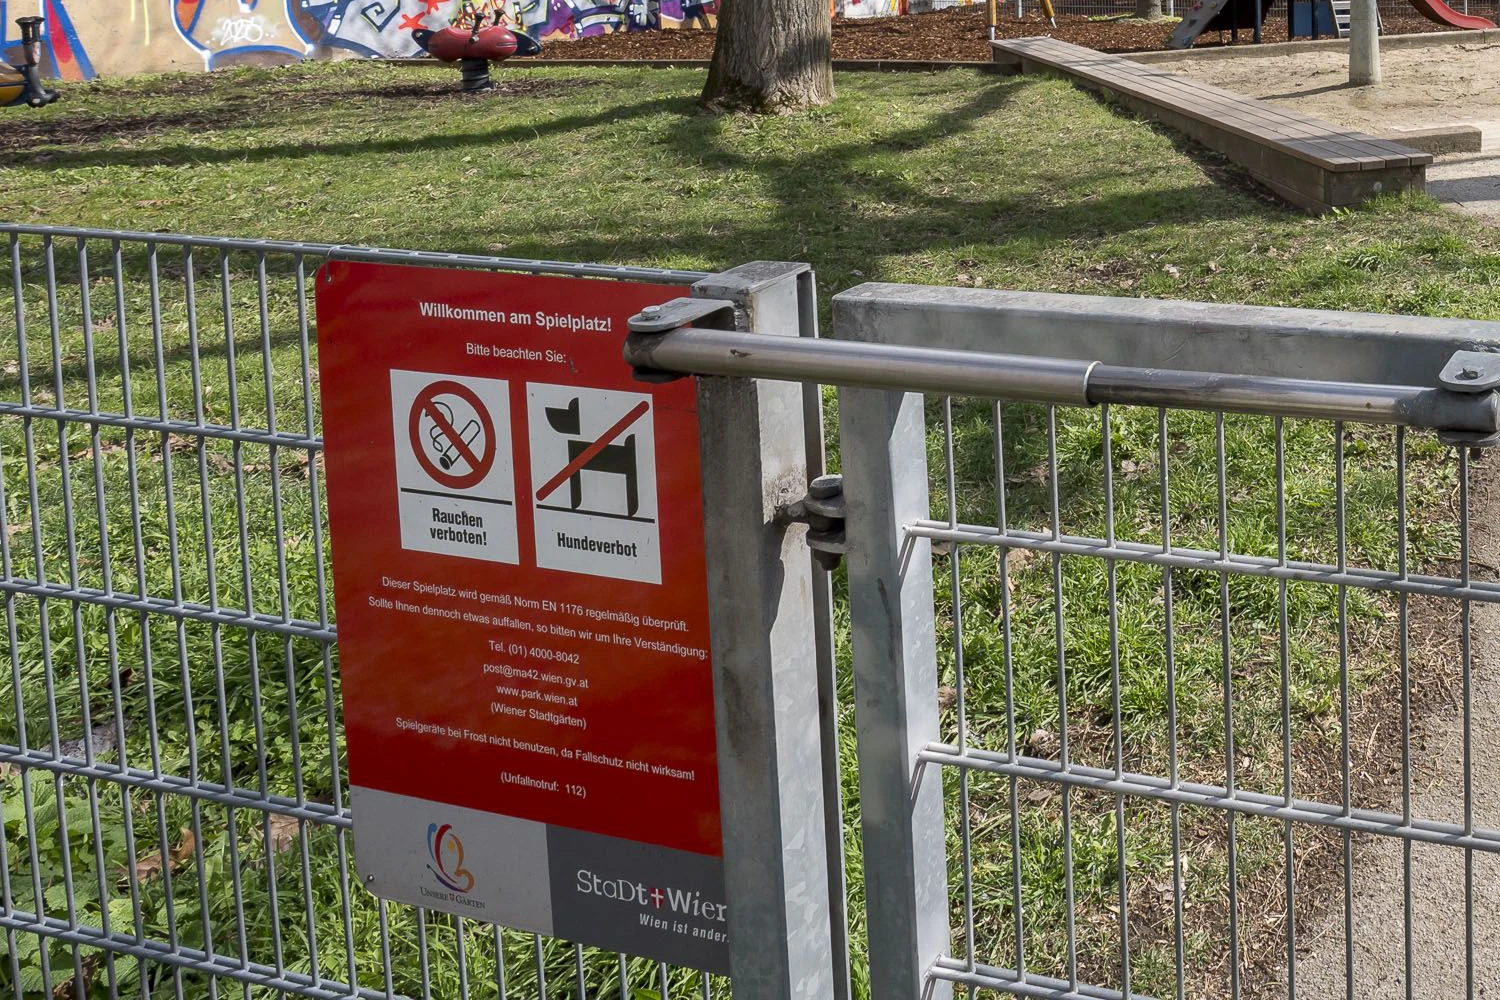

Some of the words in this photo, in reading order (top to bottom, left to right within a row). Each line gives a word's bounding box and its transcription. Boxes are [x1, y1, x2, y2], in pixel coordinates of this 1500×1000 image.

[420, 302, 505, 322] Willkommen
[510, 313, 531, 324] am
[536, 312, 611, 332] Spielplatz!
[466, 343, 490, 356] Bitte
[493, 345, 542, 360] beachten
[546, 350, 566, 363] Sie:
[432, 508, 483, 528] Rauchen
[430, 527, 486, 545] verboten!
[557, 532, 637, 557] Hundeverbot
[382, 576, 411, 589] Dieser
[413, 581, 456, 596] Spielplatz
[458, 589, 477, 599] wird
[480, 593, 512, 605] gemäß
[514, 596, 539, 609] Norm
[542, 600, 556, 612] EN
[560, 603, 583, 615] 1176
[586, 609, 639, 626] regelmäßig
[642, 616, 688, 631] überprüft.
[369, 596, 393, 609] Sollte
[396, 600, 420, 613] Ihnen
[423, 605, 460, 619] dennoch
[463, 612, 490, 624] etwas
[492, 617, 533, 632] auffallen,
[537, 624, 548, 633] so
[550, 624, 576, 637] bitten
[578, 630, 592, 639] wir
[595, 634, 610, 643] um
[613, 634, 631, 646] Ihre
[634, 637, 707, 660] Verständigung:
[489, 640, 505, 652] Tel.
[509, 644, 527, 658] (01)
[529, 648, 579, 664] 4000-8042
[484, 664, 588, 688] post@ma42.wien.gv.at
[497, 685, 579, 706] www.park.wien.at
[491, 702, 526, 716] (Wiener
[529, 709, 586, 729] Stadtgärten)
[396, 717, 445, 735] Spielgeräte
[448, 727, 461, 738] bei
[464, 730, 487, 743] Frost
[489, 735, 511, 747] nicht
[513, 738, 558, 756] benutzen,
[561, 748, 573, 758] da
[576, 750, 623, 768] Fallschutz
[626, 760, 649, 772] nicht
[651, 765, 694, 780] wirksam!
[501, 772, 559, 791] (Unfallnotruf:
[566, 784, 586, 799] 112)
[640, 913, 667, 929] Wien
[673, 921, 687, 934] ist
[693, 928, 729, 942] ander
